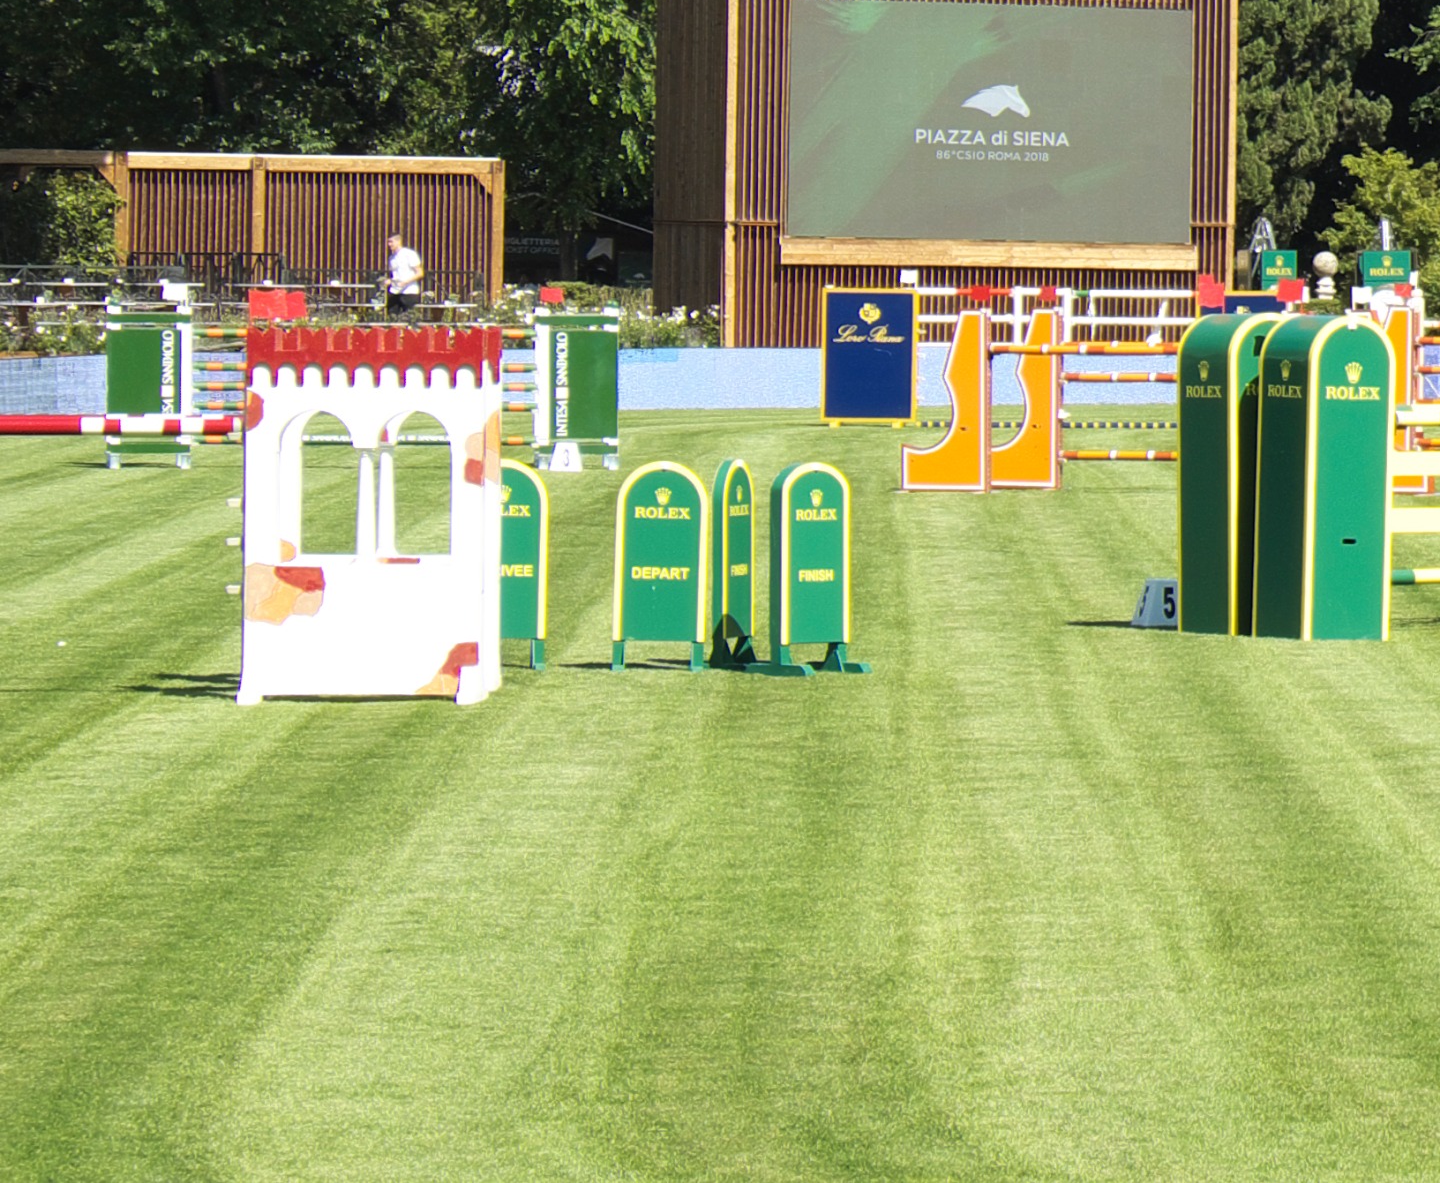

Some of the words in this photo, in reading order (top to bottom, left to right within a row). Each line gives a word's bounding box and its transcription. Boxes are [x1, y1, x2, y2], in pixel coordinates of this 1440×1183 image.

[915, 128, 987, 145] PIAZZA
[991, 130, 1008, 146] di
[1012, 131, 1070, 147] SIENA
[988, 151, 1021, 161] ROMA
[1024, 152, 1049, 162] 2018
[1266, 267, 1292, 276] ROLEX
[1369, 267, 1405, 277] ROLEX
[1186, 385, 1222, 399] ROLEX
[1267, 384, 1303, 399] ROLEX
[1325, 385, 1381, 401] ROLEX
[556, 400, 568, 437] INTESA
[500, 504, 532, 518] LEX
[634, 506, 691, 520] ROLEX
[729, 504, 749, 518] ROLEX
[795, 508, 838, 522] ROLEX
[500, 564, 534, 578] IVEE
[631, 566, 690, 581] DEPART
[730, 564, 749, 578] FINISH
[798, 569, 835, 583] FINISH
[1163, 586, 1176, 620] 5
